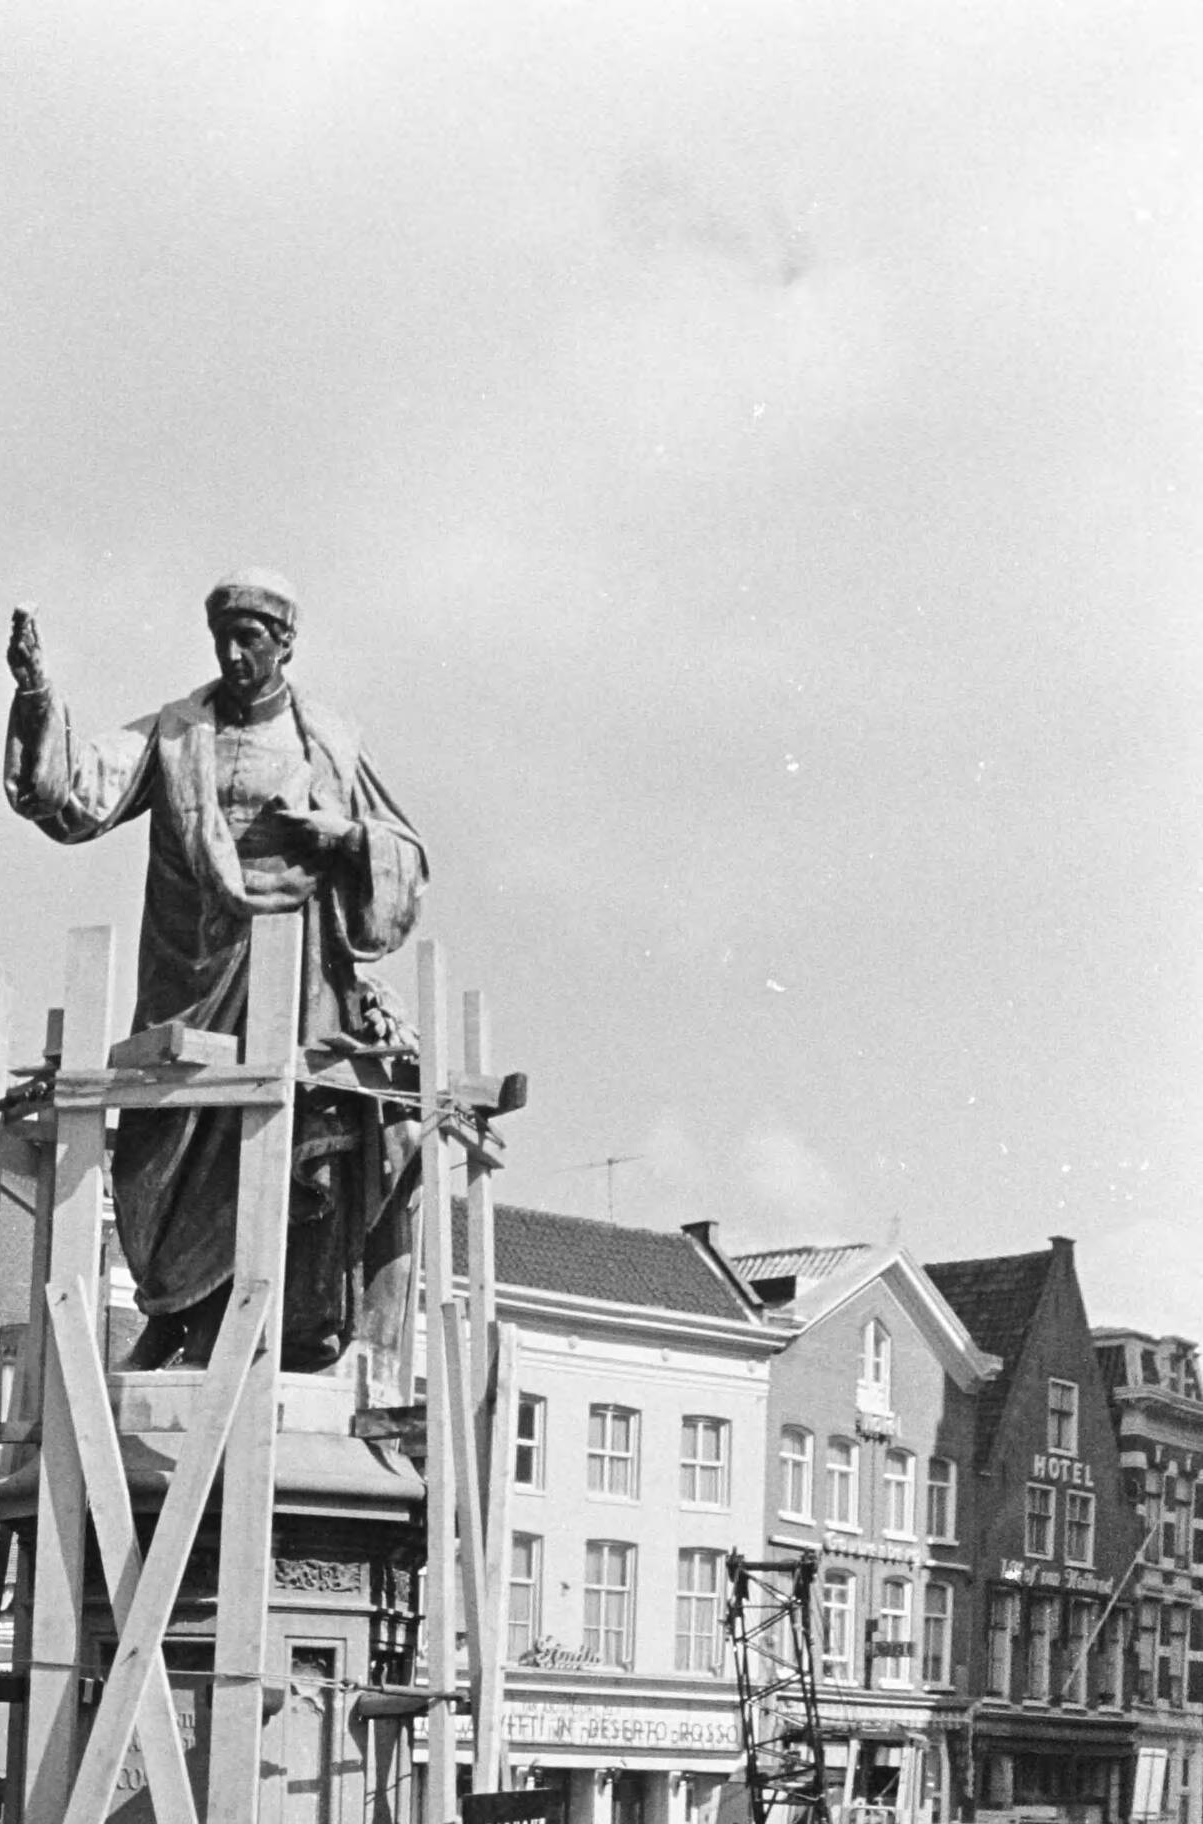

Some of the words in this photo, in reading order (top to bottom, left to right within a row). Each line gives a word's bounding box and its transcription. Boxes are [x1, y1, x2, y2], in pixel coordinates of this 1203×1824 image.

[1033, 1454, 1095, 1487] HOTEL
[588, 1718, 667, 1742] DESERTO
[679, 1721, 739, 1744] ROSSO
